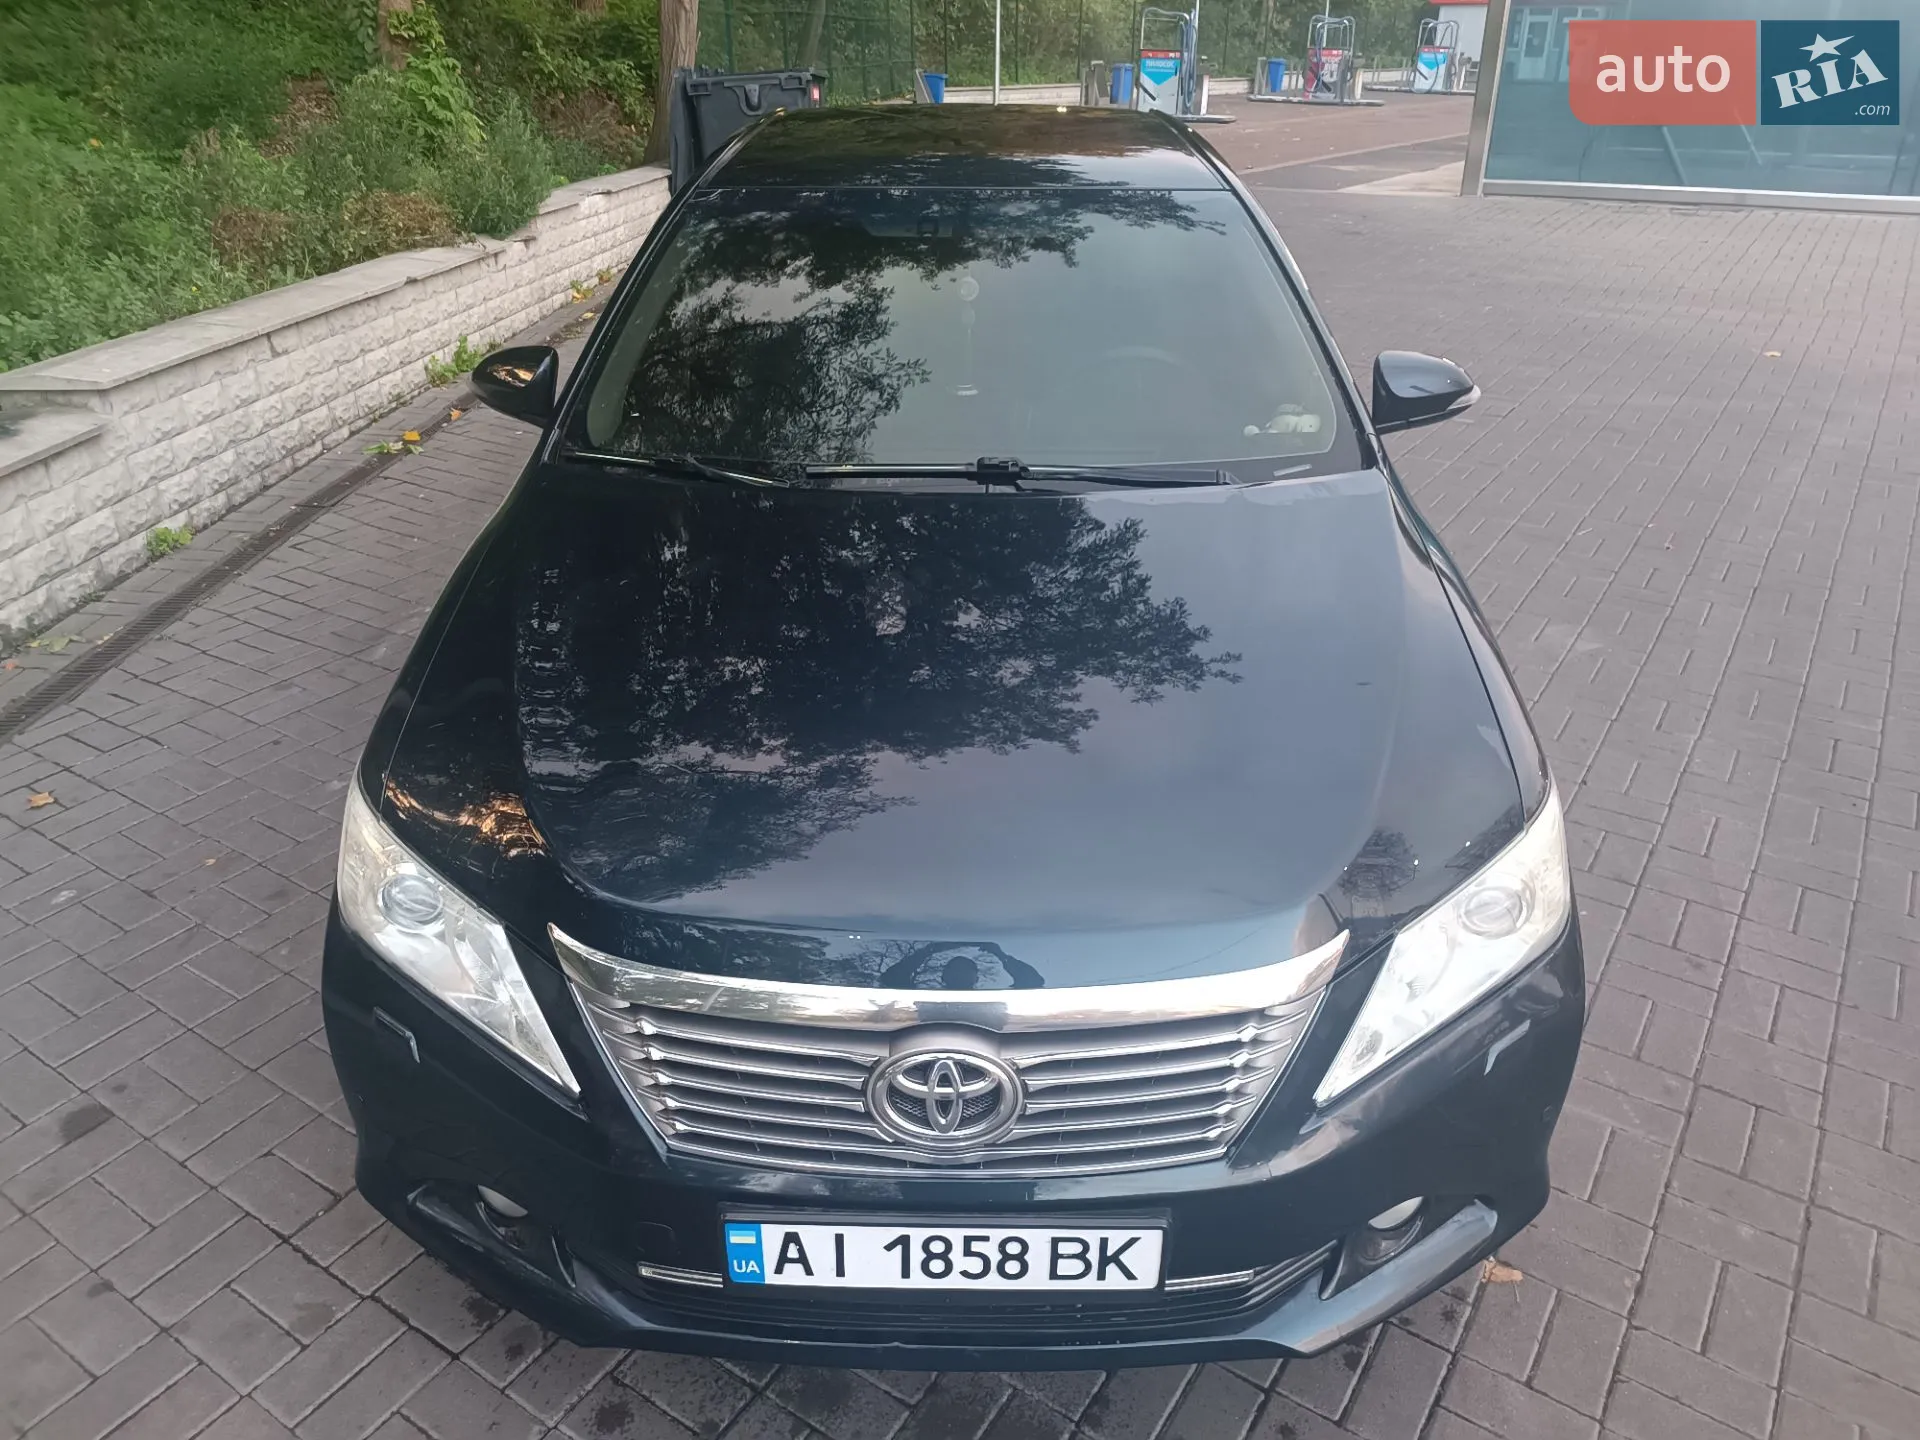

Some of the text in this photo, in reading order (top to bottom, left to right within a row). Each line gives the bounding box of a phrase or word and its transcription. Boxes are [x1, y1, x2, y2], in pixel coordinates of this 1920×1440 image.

[733, 1259, 761, 1274] UA
[773, 1231, 1142, 1281] AI 1858 BK
